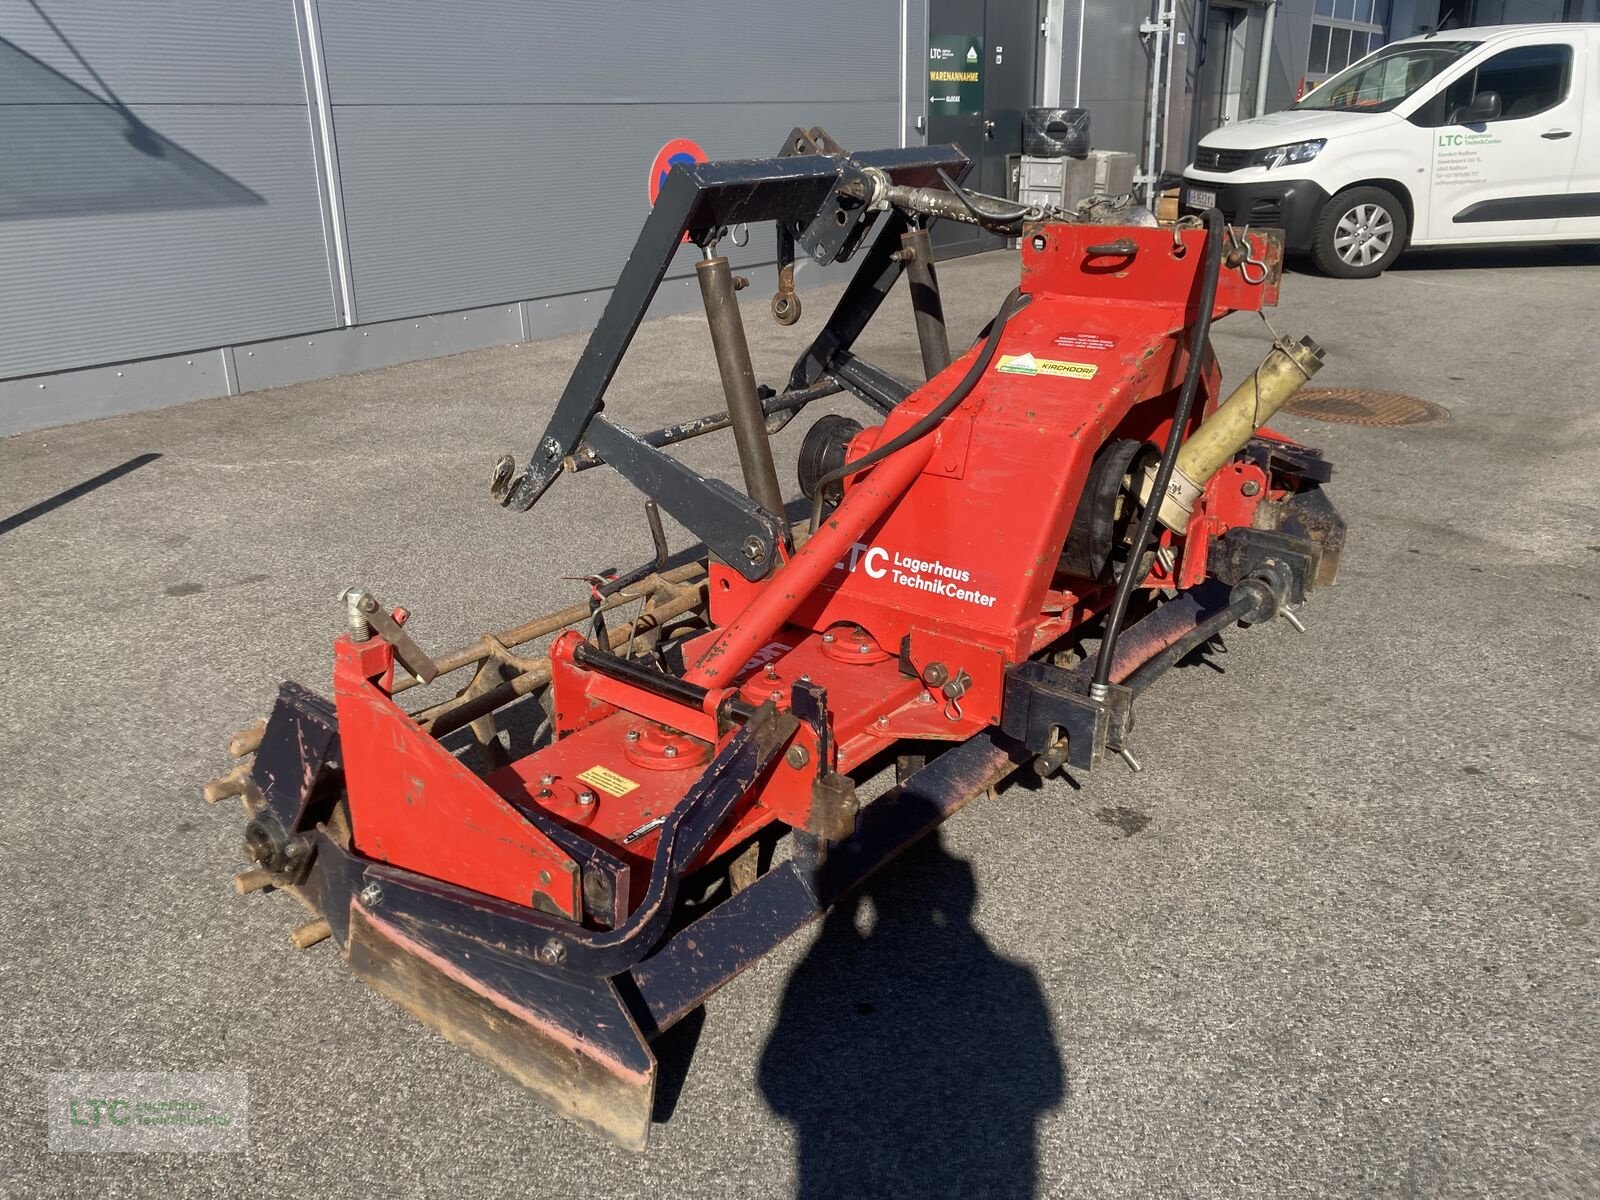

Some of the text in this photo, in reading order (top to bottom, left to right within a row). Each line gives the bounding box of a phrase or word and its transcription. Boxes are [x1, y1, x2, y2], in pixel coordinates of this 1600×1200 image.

[930, 48, 941, 59] LTC
[929, 71, 979, 82] WARENANNAHME
[1439, 134, 1463, 147] LTC
[1041, 363, 1096, 374] KIRCHDORF
[894, 552, 970, 582] Lagerhaus
[891, 570, 997, 608] TechnikCenter
